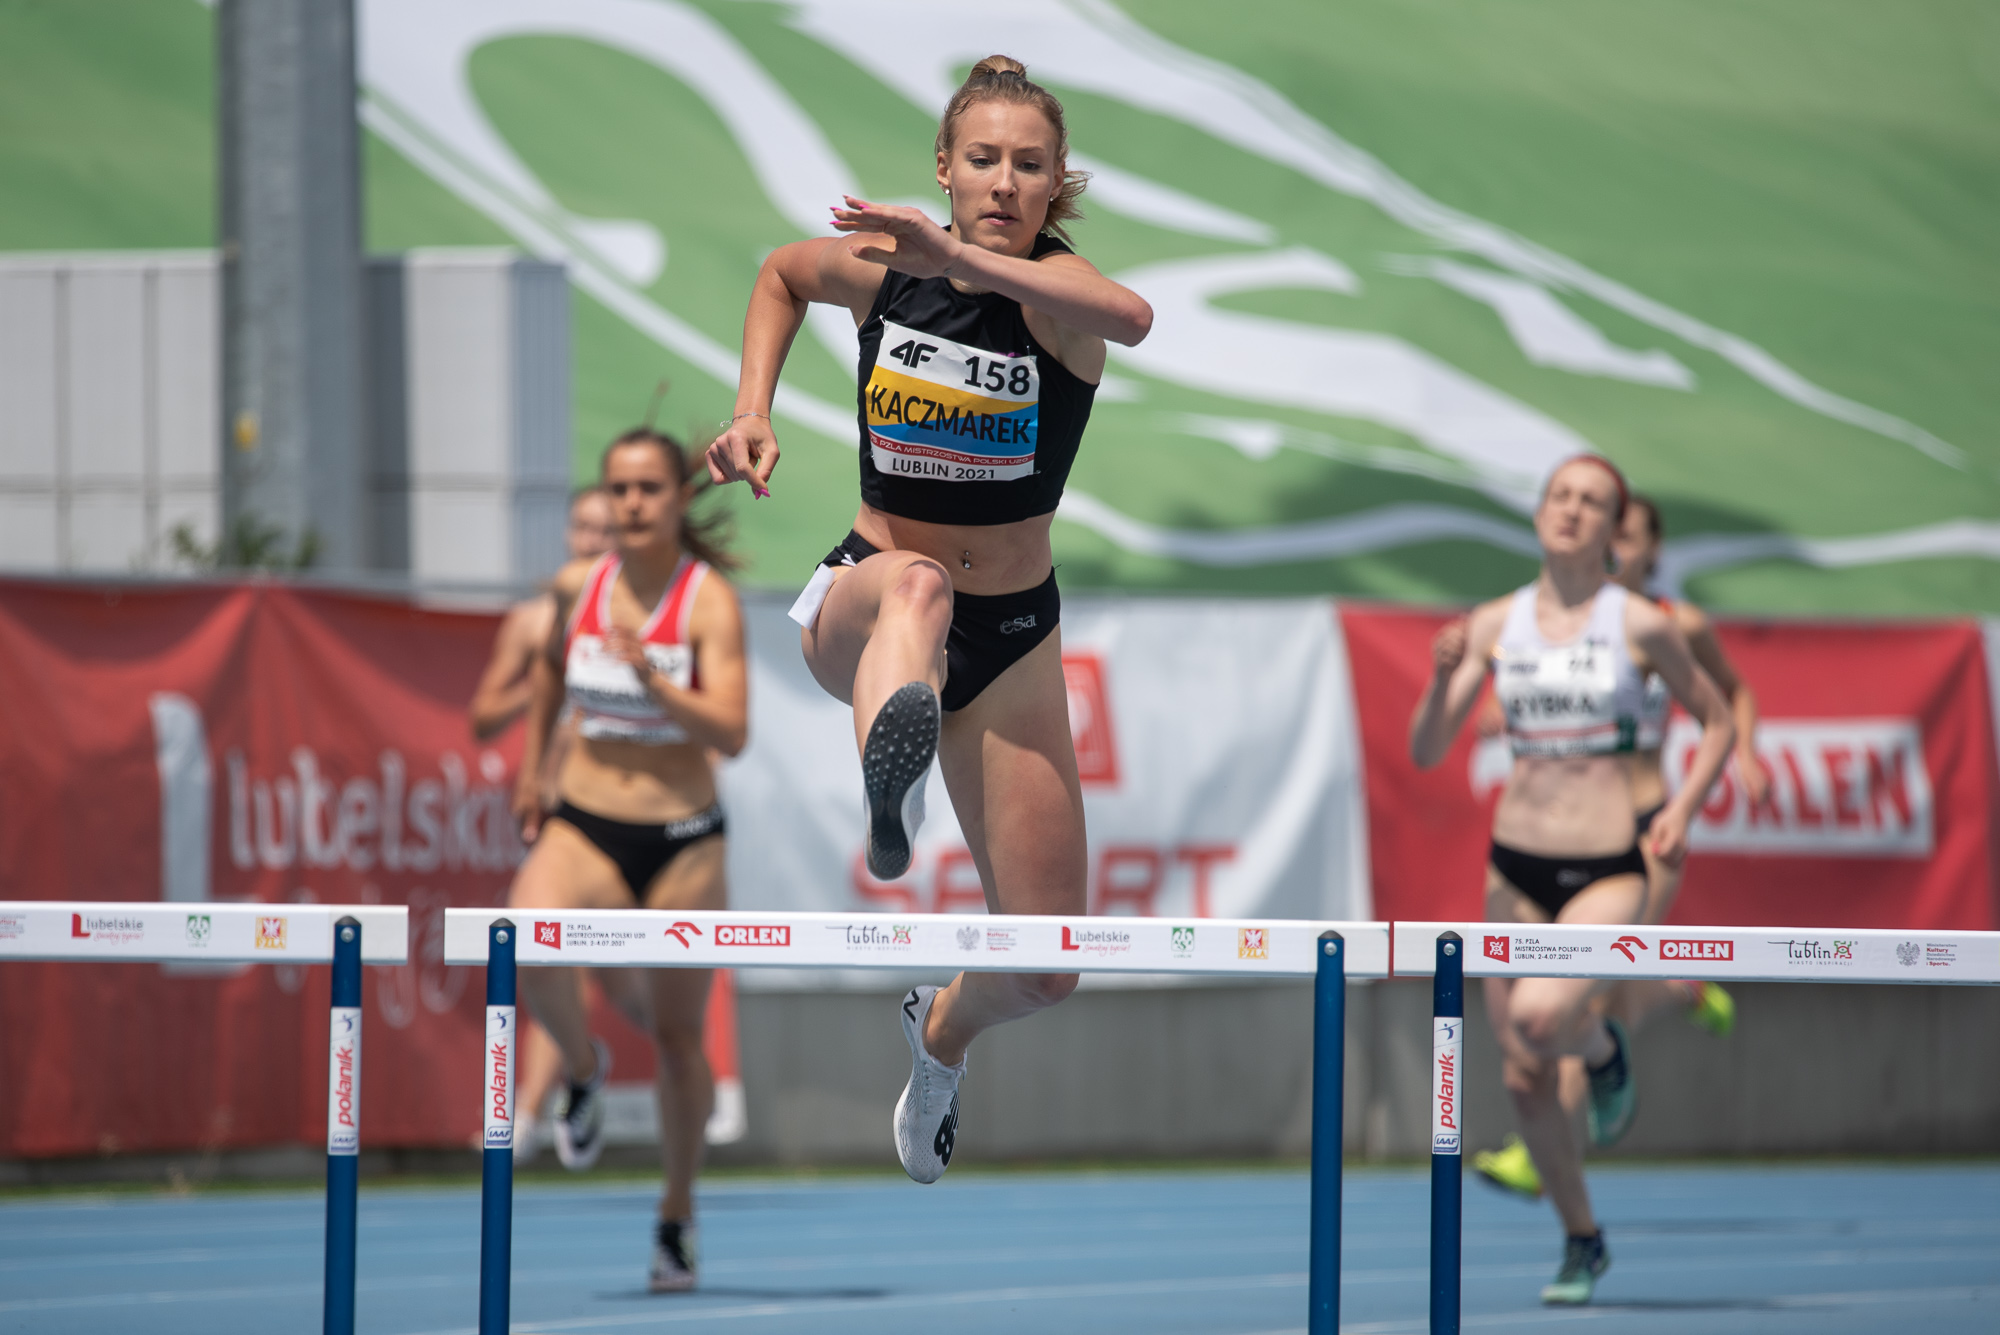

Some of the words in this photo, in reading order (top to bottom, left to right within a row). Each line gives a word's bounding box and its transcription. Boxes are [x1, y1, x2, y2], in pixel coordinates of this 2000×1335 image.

[889, 340, 939, 369] 4F
[964, 355, 1030, 396] 158
[870, 384, 1031, 444] KACZMAREK
[880, 439, 902, 452] PZLA
[904, 446, 972, 464] MISTRZOSTWA
[973, 456, 1007, 466] POLSKI
[1008, 457, 1029, 465] U20
[892, 458, 949, 478] LUBLIN
[954, 466, 996, 480] 2021
[86, 917, 144, 931] lubelskie
[566, 932, 609, 940] MISTRZOSTWA
[611, 932, 631, 940] POLSKI
[633, 932, 646, 940] U20
[717, 926, 788, 945] ORLEN
[1075, 931, 1130, 943] lubelskie
[1239, 949, 1267, 959] PZLA
[1514, 953, 1537, 961] LUBLIN,
[1538, 953, 1573, 961] 2-4.07.2021
[1662, 942, 1730, 959] ORLEN
[336, 1046, 354, 1127] polanik
[490, 1043, 510, 1121] polanik
[1437, 1053, 1456, 1130] polanik
[489, 1130, 510, 1138] IAAF
